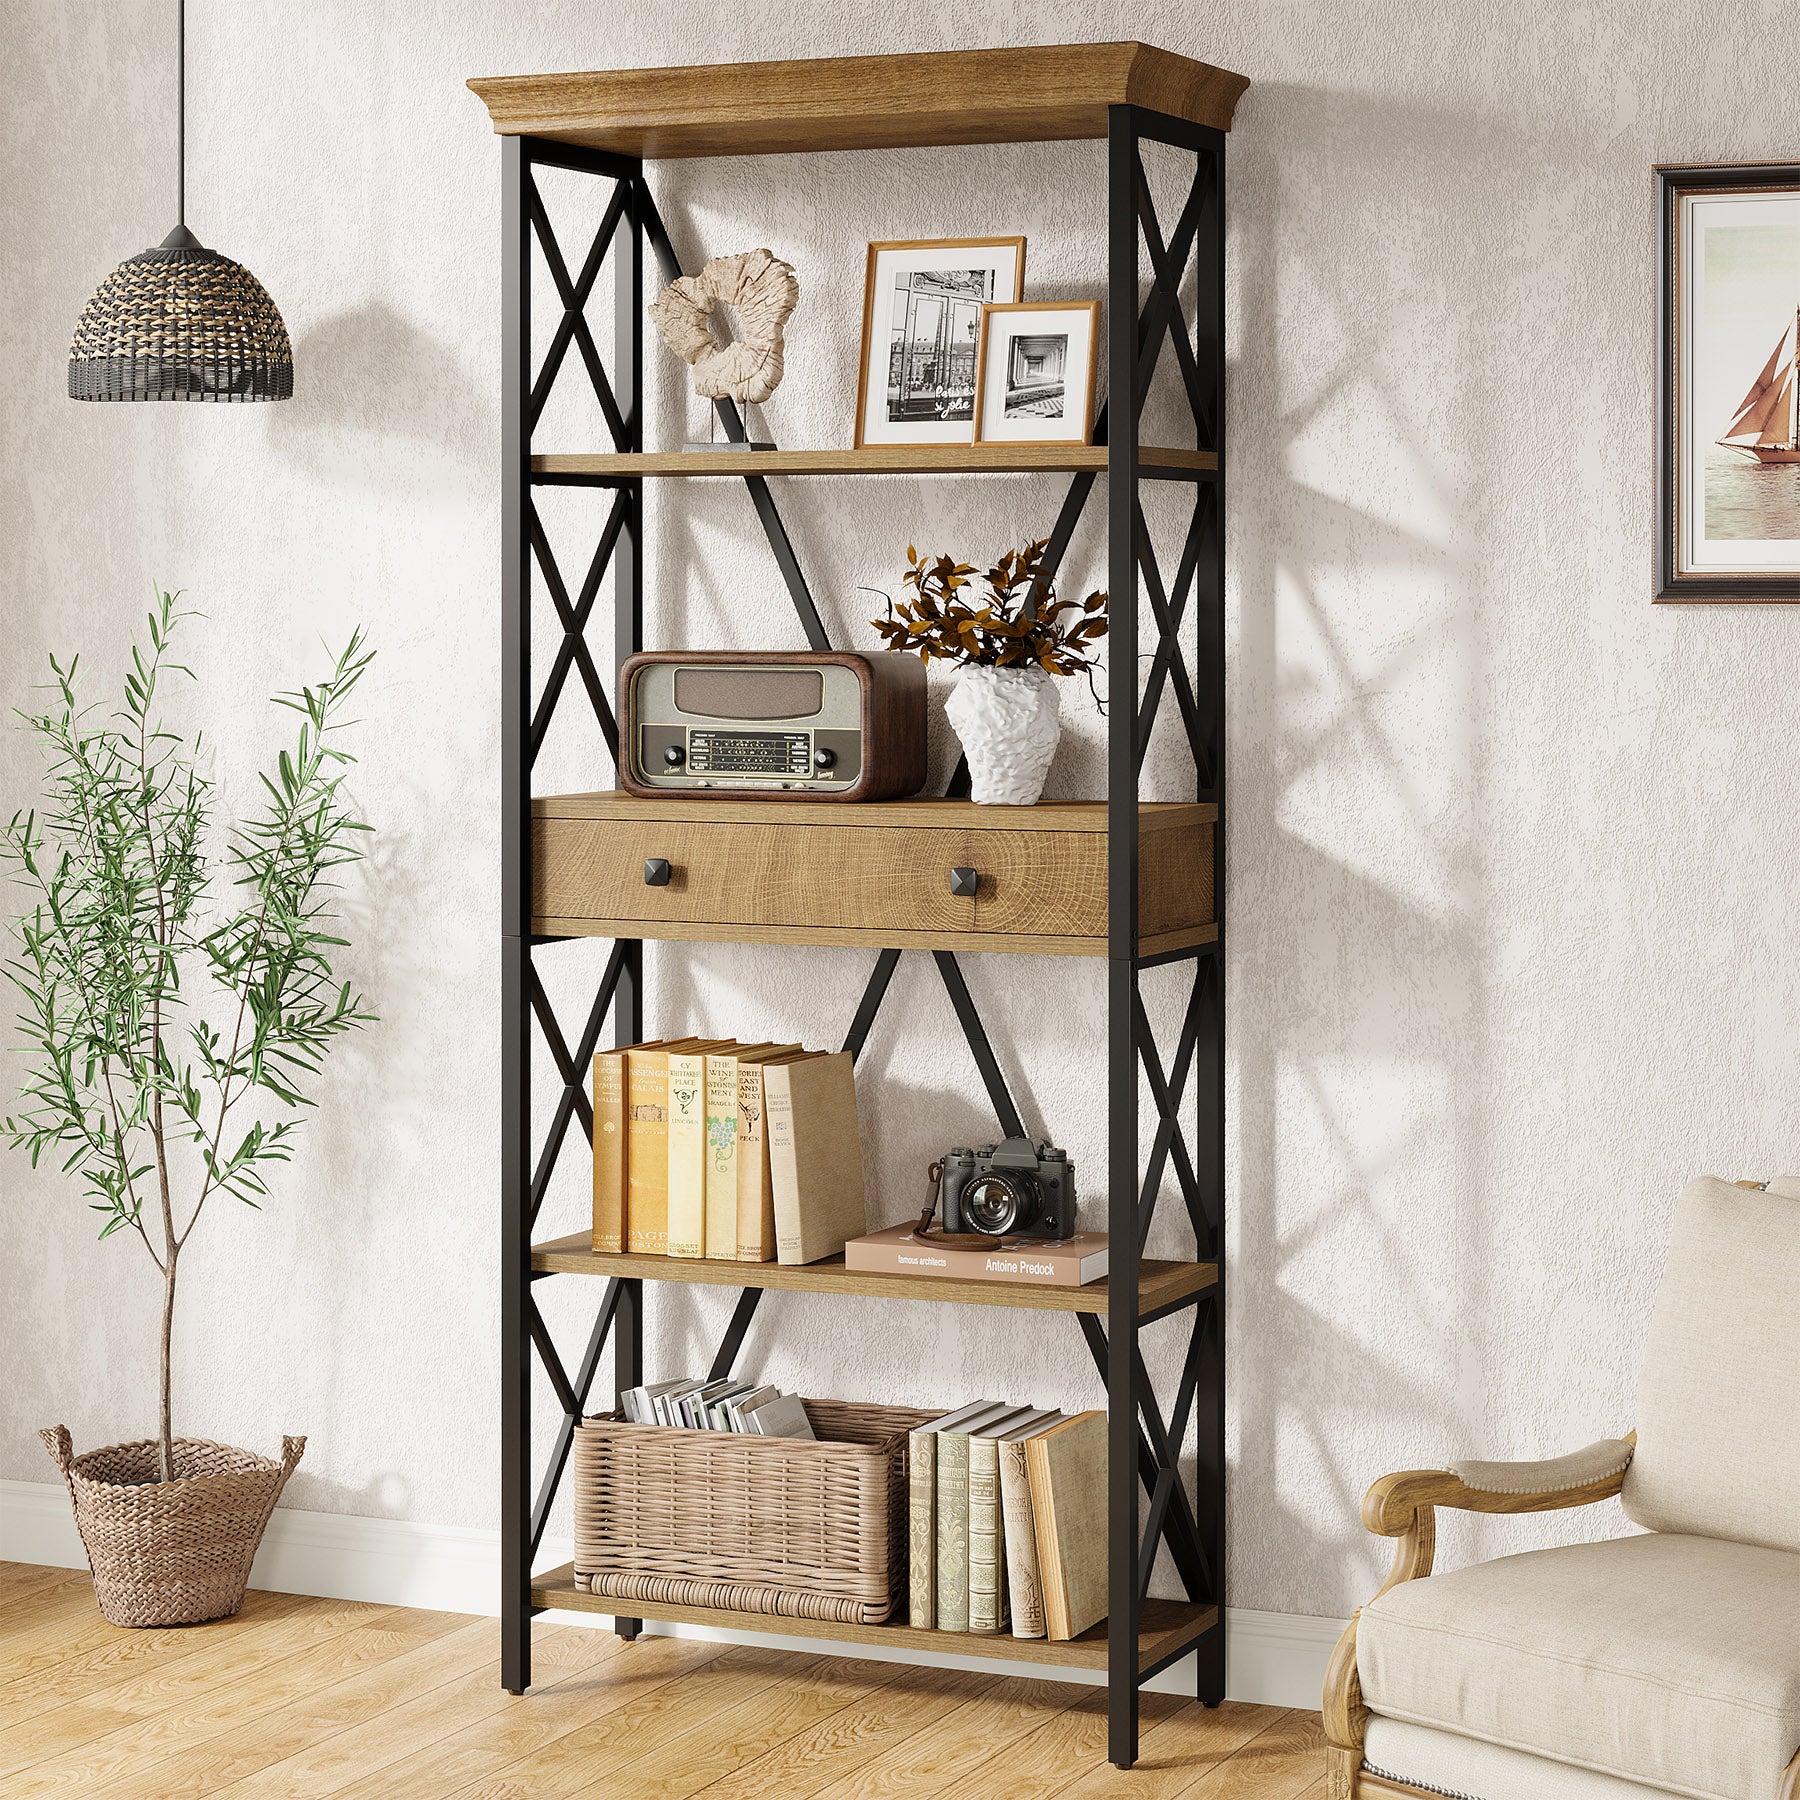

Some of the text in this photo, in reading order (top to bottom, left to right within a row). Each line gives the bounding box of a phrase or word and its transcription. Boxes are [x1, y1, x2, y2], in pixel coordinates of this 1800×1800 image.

[935, 384, 976, 398] Paris es
[934, 398, 971, 419] si jolie
[708, 1069, 734, 1077] WINE
[628, 1230, 668, 1241] PAGE
[897, 1255, 947, 1267] famous architects
[985, 1258, 1055, 1276] Antoine Predock
